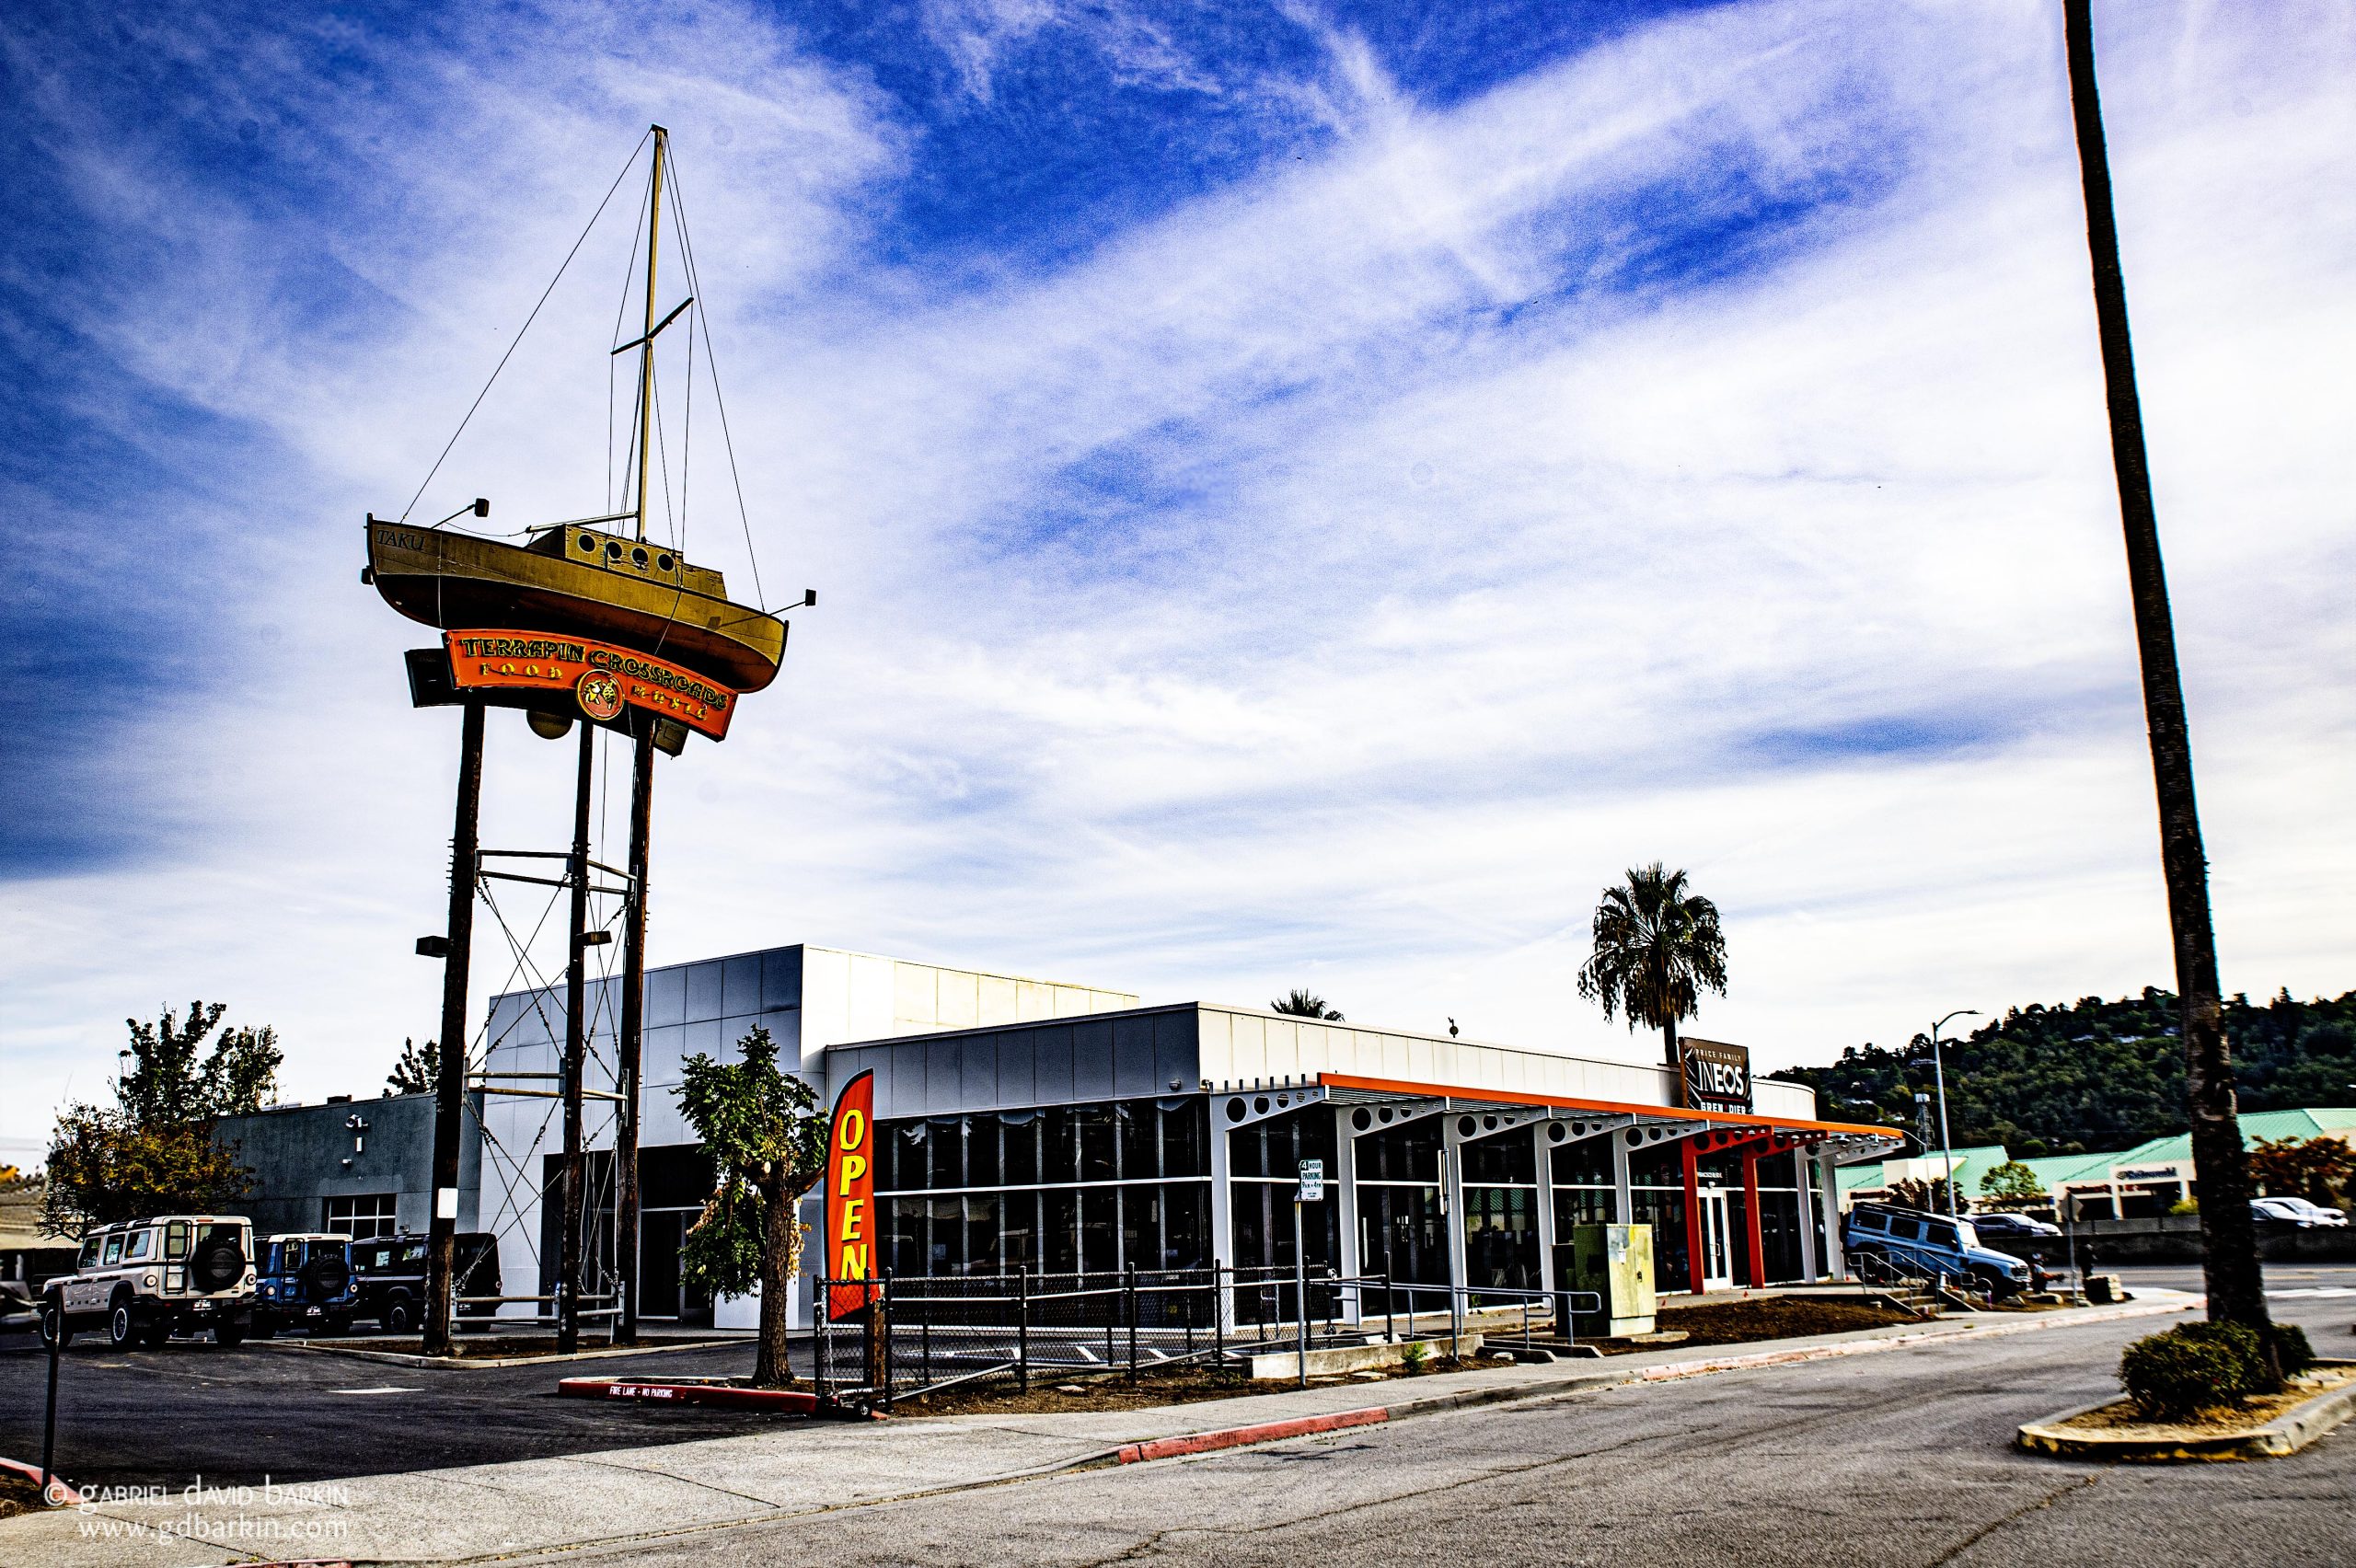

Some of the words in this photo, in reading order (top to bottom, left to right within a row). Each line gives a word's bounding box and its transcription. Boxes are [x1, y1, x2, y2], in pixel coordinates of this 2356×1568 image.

[376, 529, 425, 550] TAKU
[461, 638, 586, 663] TERRAPIN
[588, 649, 729, 710] CROSSROADS
[479, 663, 563, 680] FOOD
[630, 684, 708, 721] MUSIC
[1695, 1048, 1716, 1058] PRICE
[1719, 1052, 1741, 1062] FAMILY
[1697, 1060, 1745, 1096] INEOS
[1301, 1160, 1307, 1170] 4
[1302, 1171, 1321, 1180] PARKING
[839, 1109, 868, 1281] OPEN
[609, 1386, 622, 1395] FIRE
[622, 1387, 637, 1396] LANE
[641, 1388, 650, 1397] NO
[651, 1389, 673, 1398] PARKING
